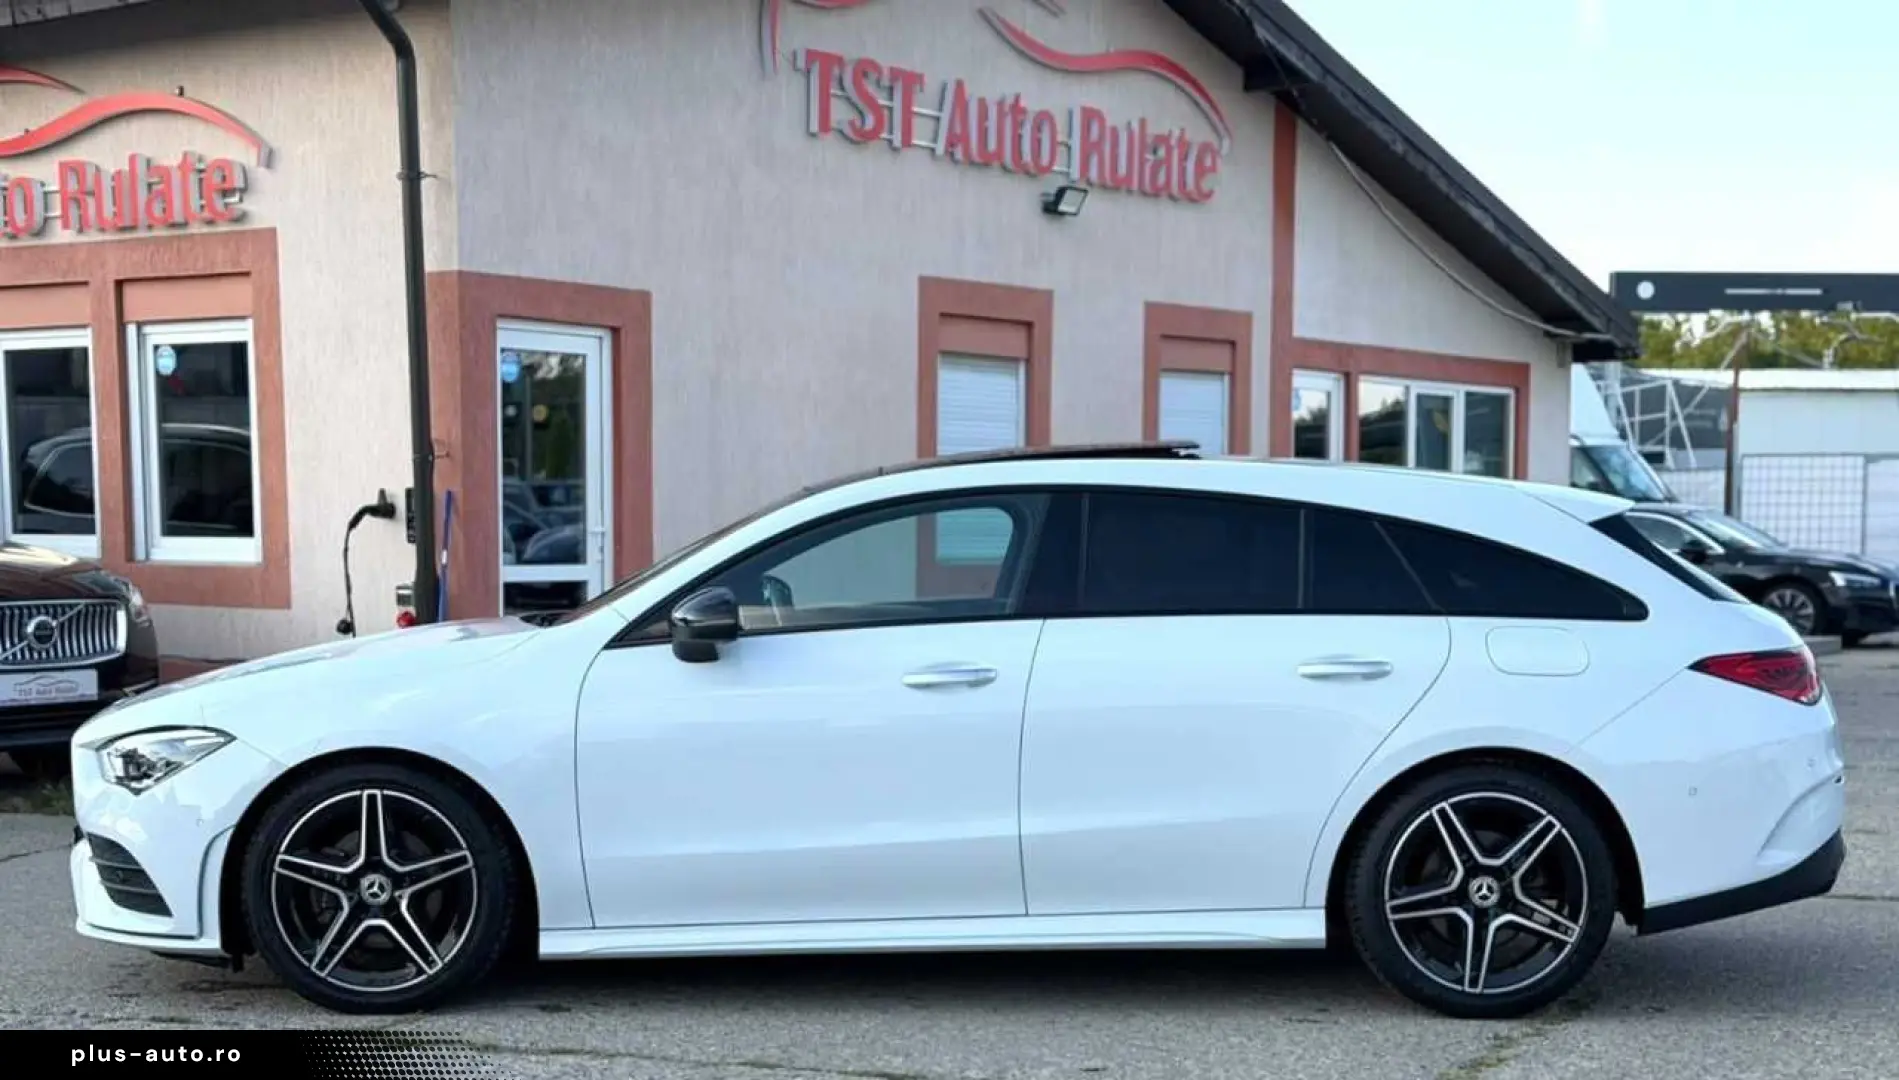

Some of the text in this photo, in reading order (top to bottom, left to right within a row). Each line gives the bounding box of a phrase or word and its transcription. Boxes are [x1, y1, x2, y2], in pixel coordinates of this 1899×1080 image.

[801, 48, 1219, 203] TST Auto Rulate
[0, 151, 243, 238] o Rulate
